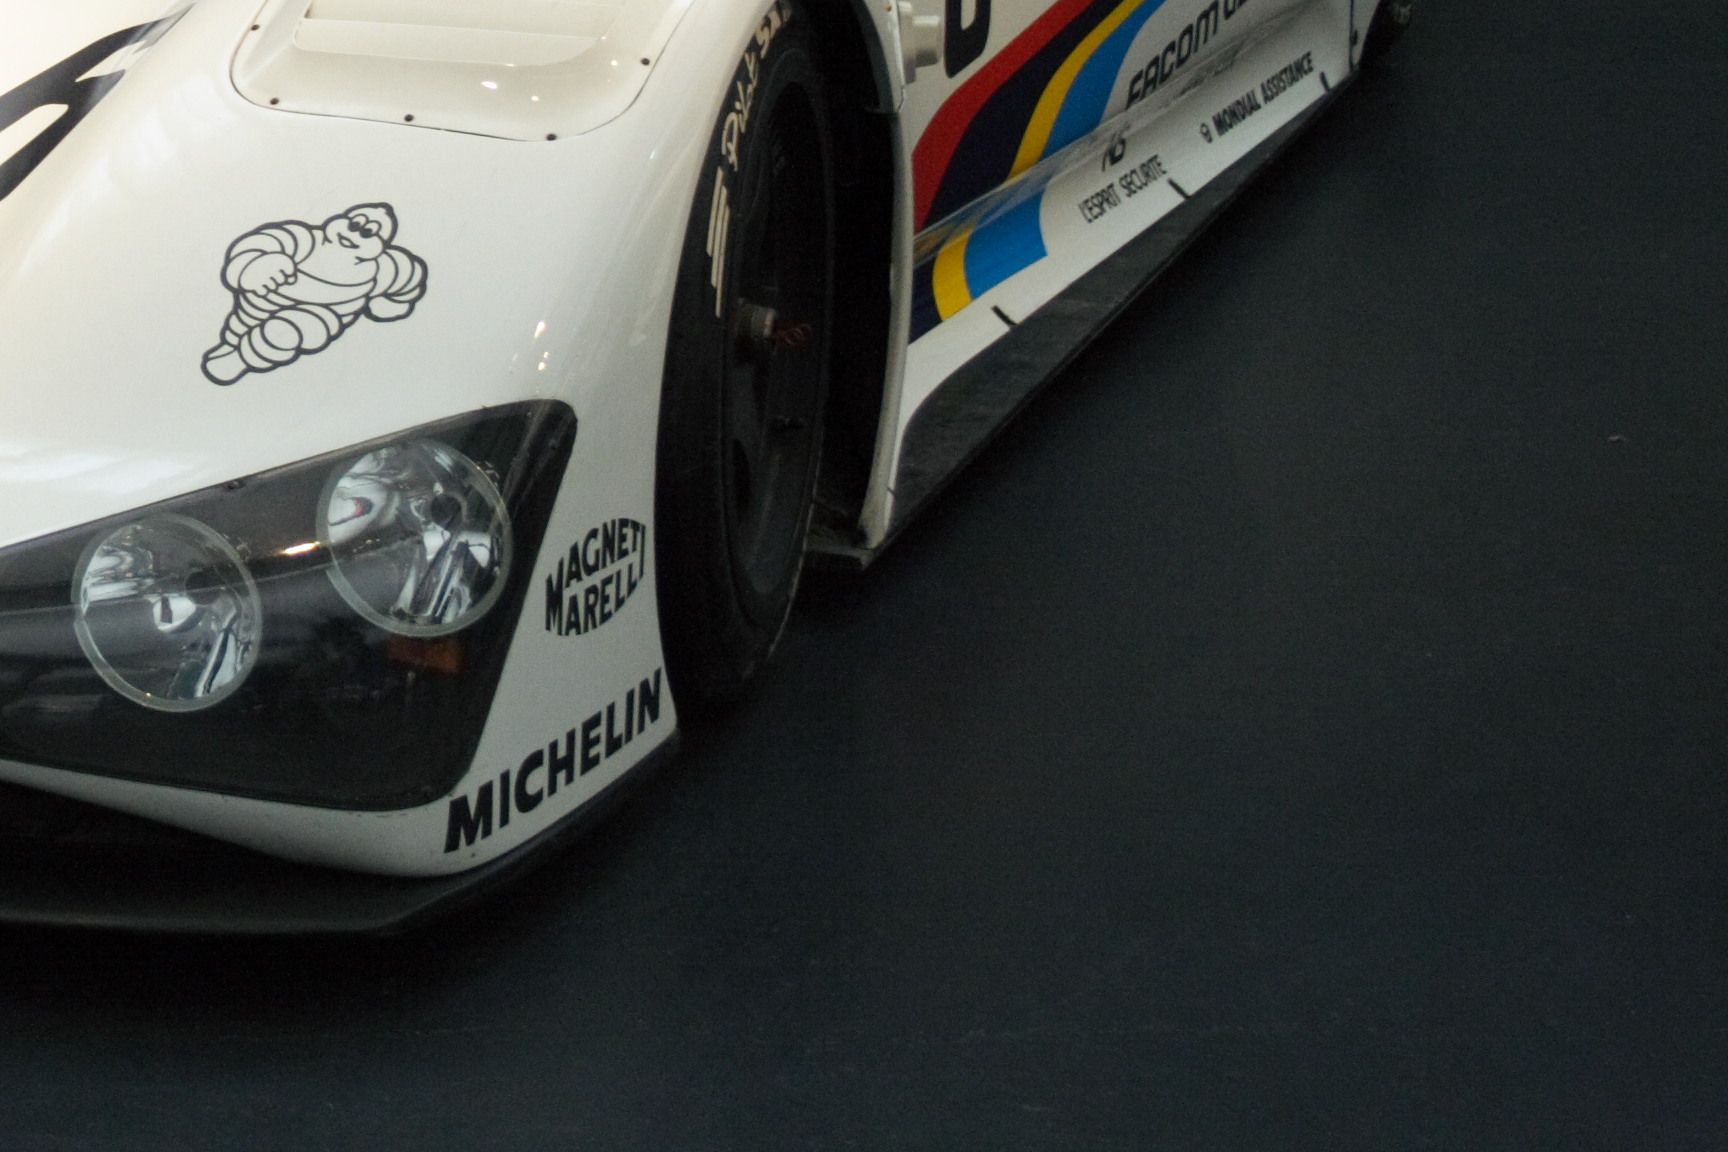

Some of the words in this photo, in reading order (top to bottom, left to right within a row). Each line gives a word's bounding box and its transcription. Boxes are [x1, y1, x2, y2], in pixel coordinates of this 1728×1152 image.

[1125, 0, 1220, 110] FACOM
[1211, 89, 1262, 137] MONDIAL
[1260, 50, 1315, 105] ASSISTANCE
[1119, 154, 1168, 198] SECURITE
[545, 517, 646, 602] MAGNETI
[545, 555, 645, 637] MARELLI
[444, 668, 661, 854] MICHELIN
